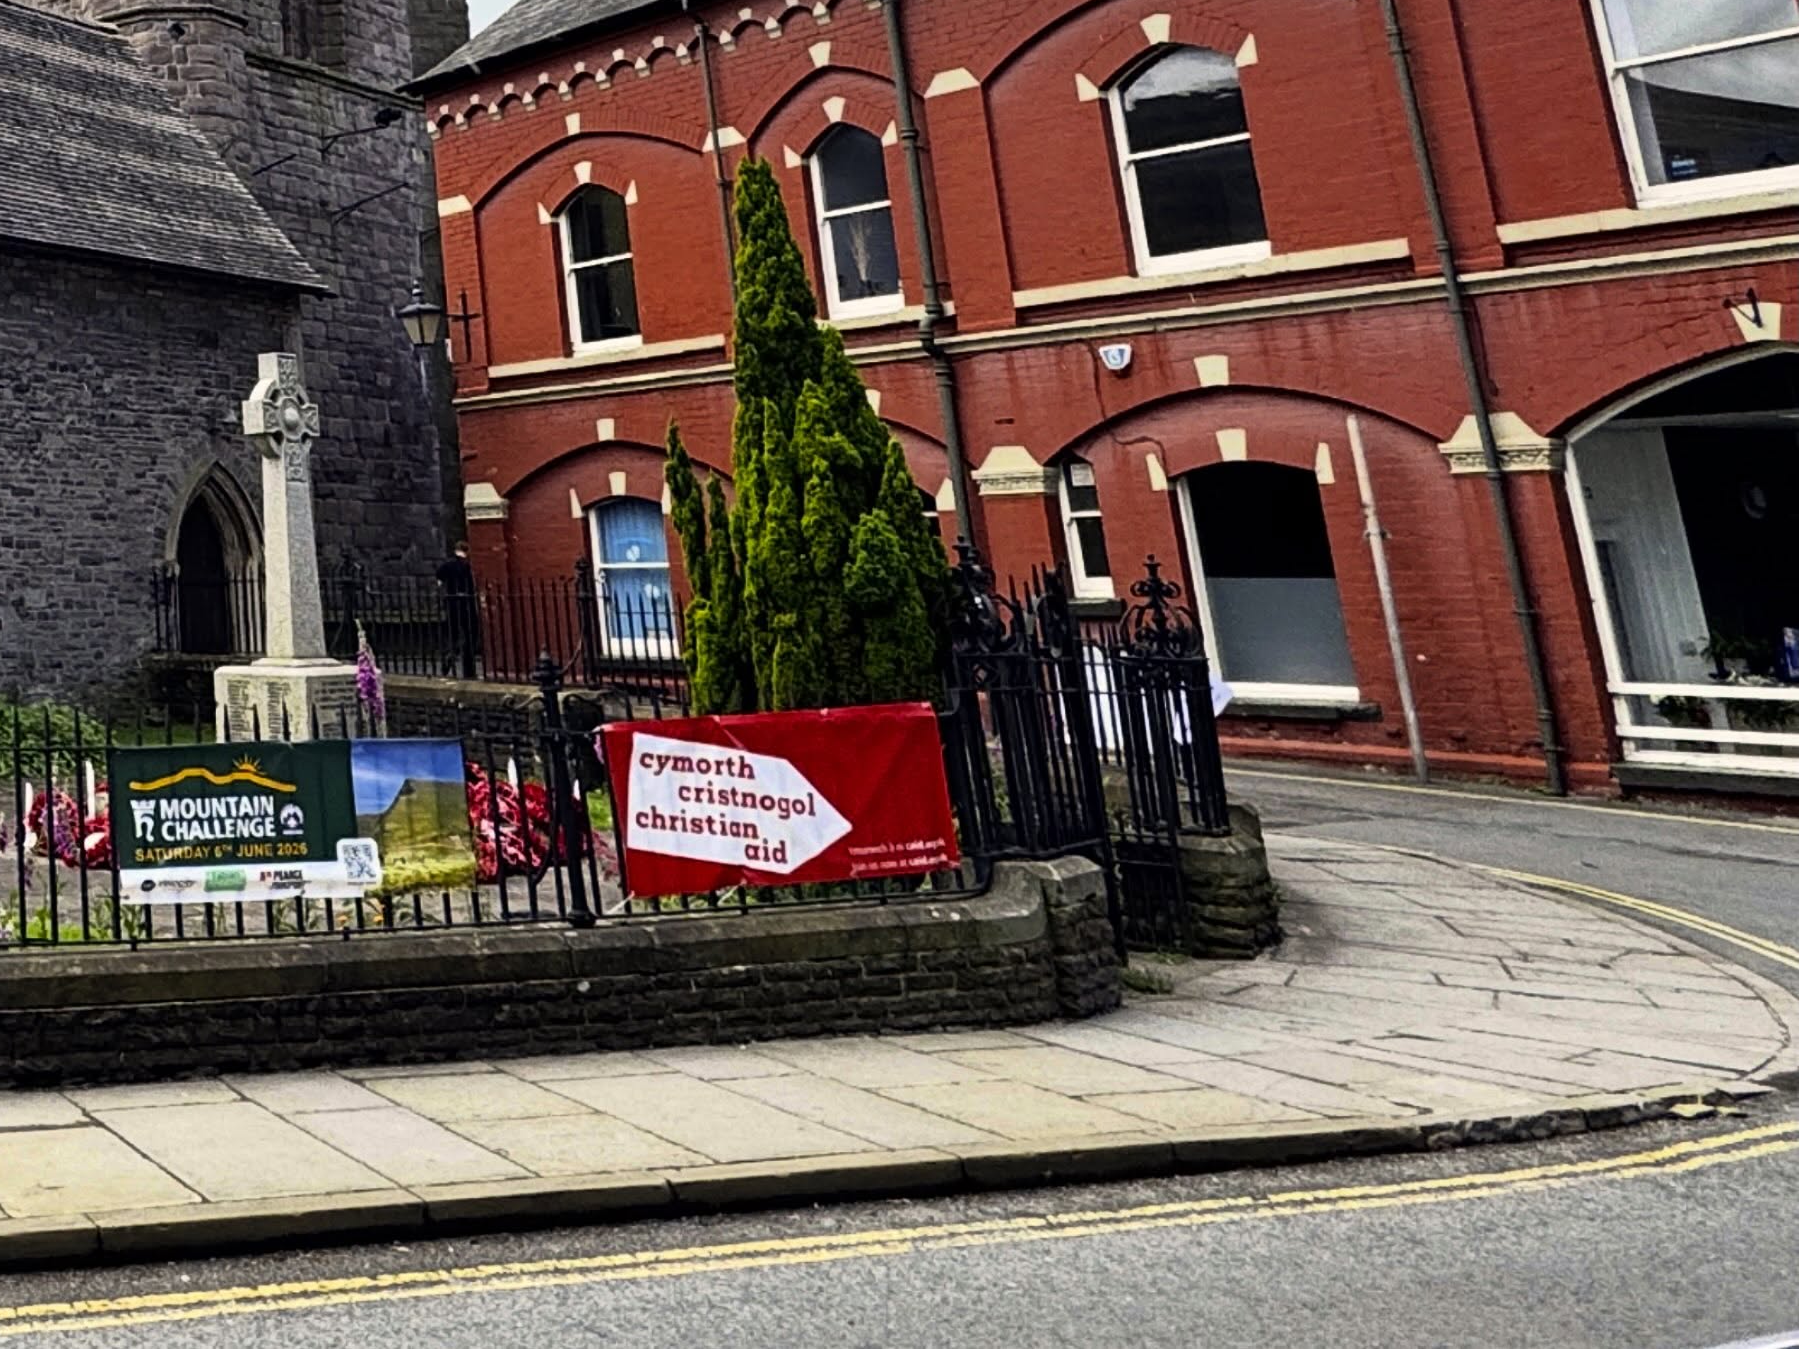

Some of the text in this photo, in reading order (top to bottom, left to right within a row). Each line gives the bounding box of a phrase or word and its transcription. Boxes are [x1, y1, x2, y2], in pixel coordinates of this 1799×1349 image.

[639, 751, 756, 780] cymorth
[159, 795, 275, 820] MOUNTAIN
[678, 781, 816, 820] cristnogol
[161, 817, 277, 841] CHALLENGE
[635, 805, 759, 839] christian
[135, 846, 209, 862] SATURDAY
[236, 843, 273, 858] JUNE
[277, 842, 308, 856] 2026
[744, 837, 788, 864] aid
